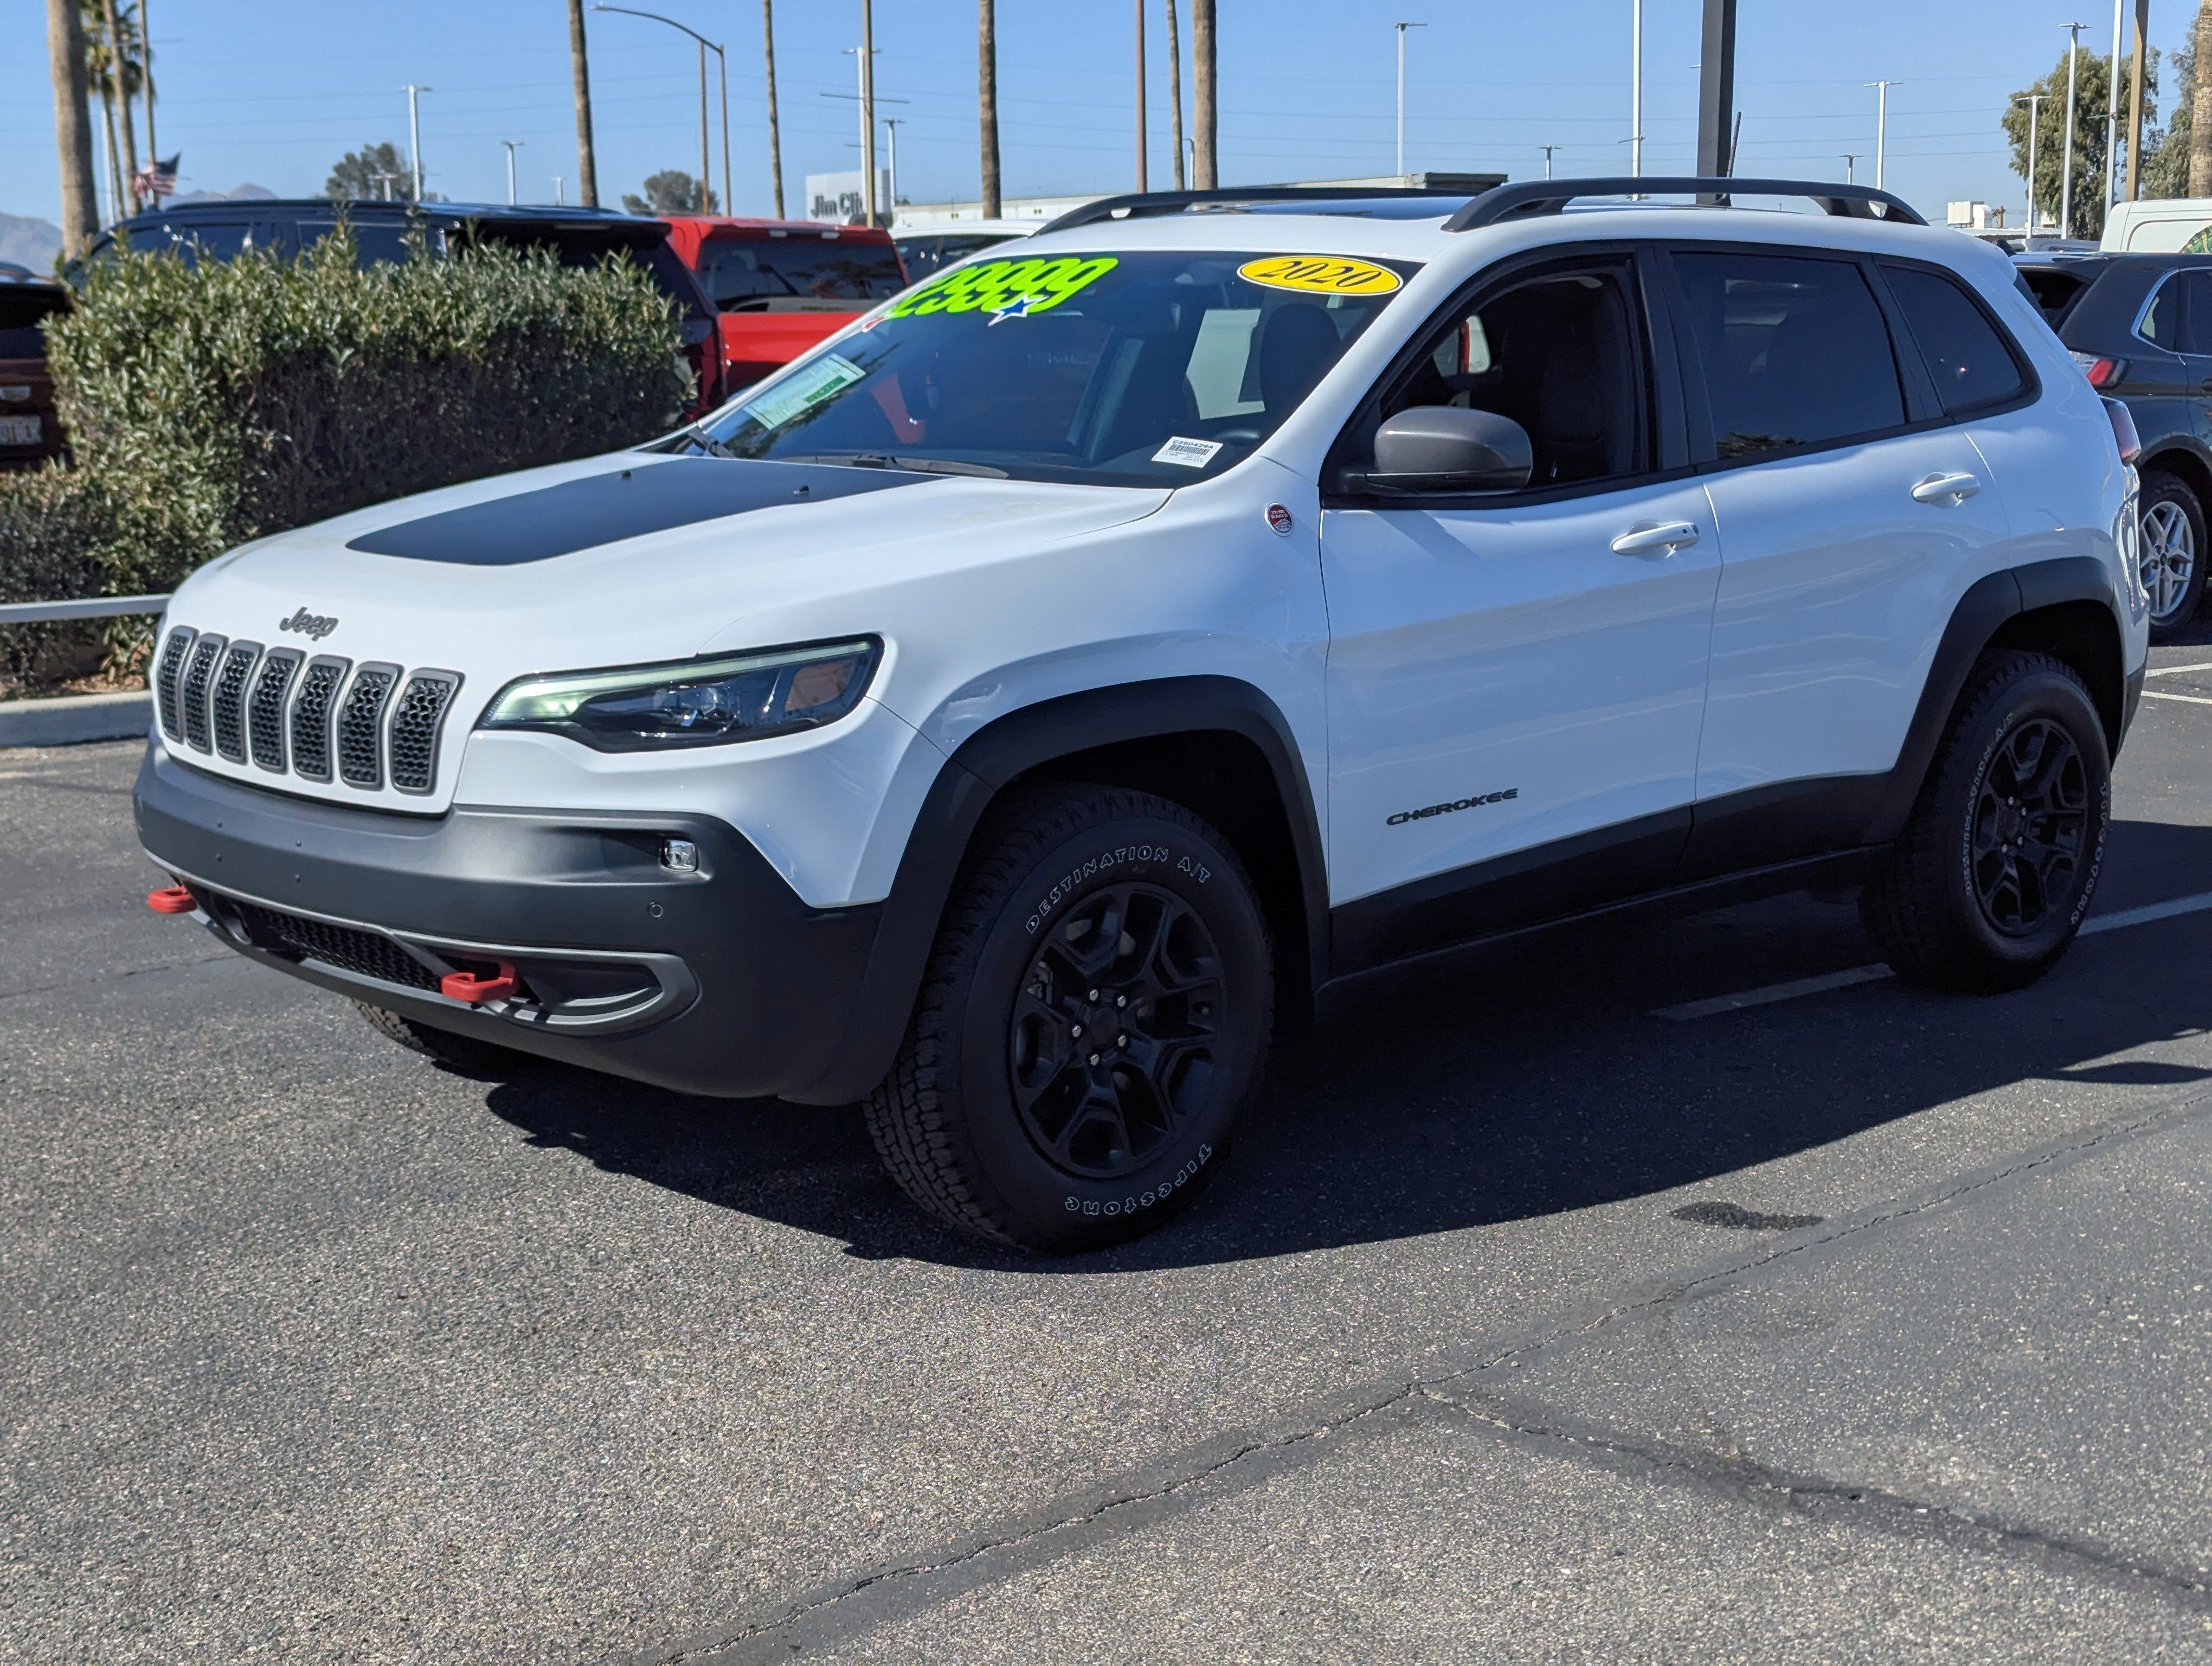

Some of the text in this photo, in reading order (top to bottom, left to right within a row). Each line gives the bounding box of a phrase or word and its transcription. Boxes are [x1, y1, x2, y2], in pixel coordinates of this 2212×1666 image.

[811, 195, 838, 218] Jim
[889, 257, 1118, 316] 29999
[1254, 261, 1382, 287] 2020
[279, 606, 339, 642] Jeep
[1386, 788, 1518, 825] CHEROKEE
[1024, 845, 1211, 934] DESTINATION A/T
[1065, 1144, 1212, 1216] Firestone
